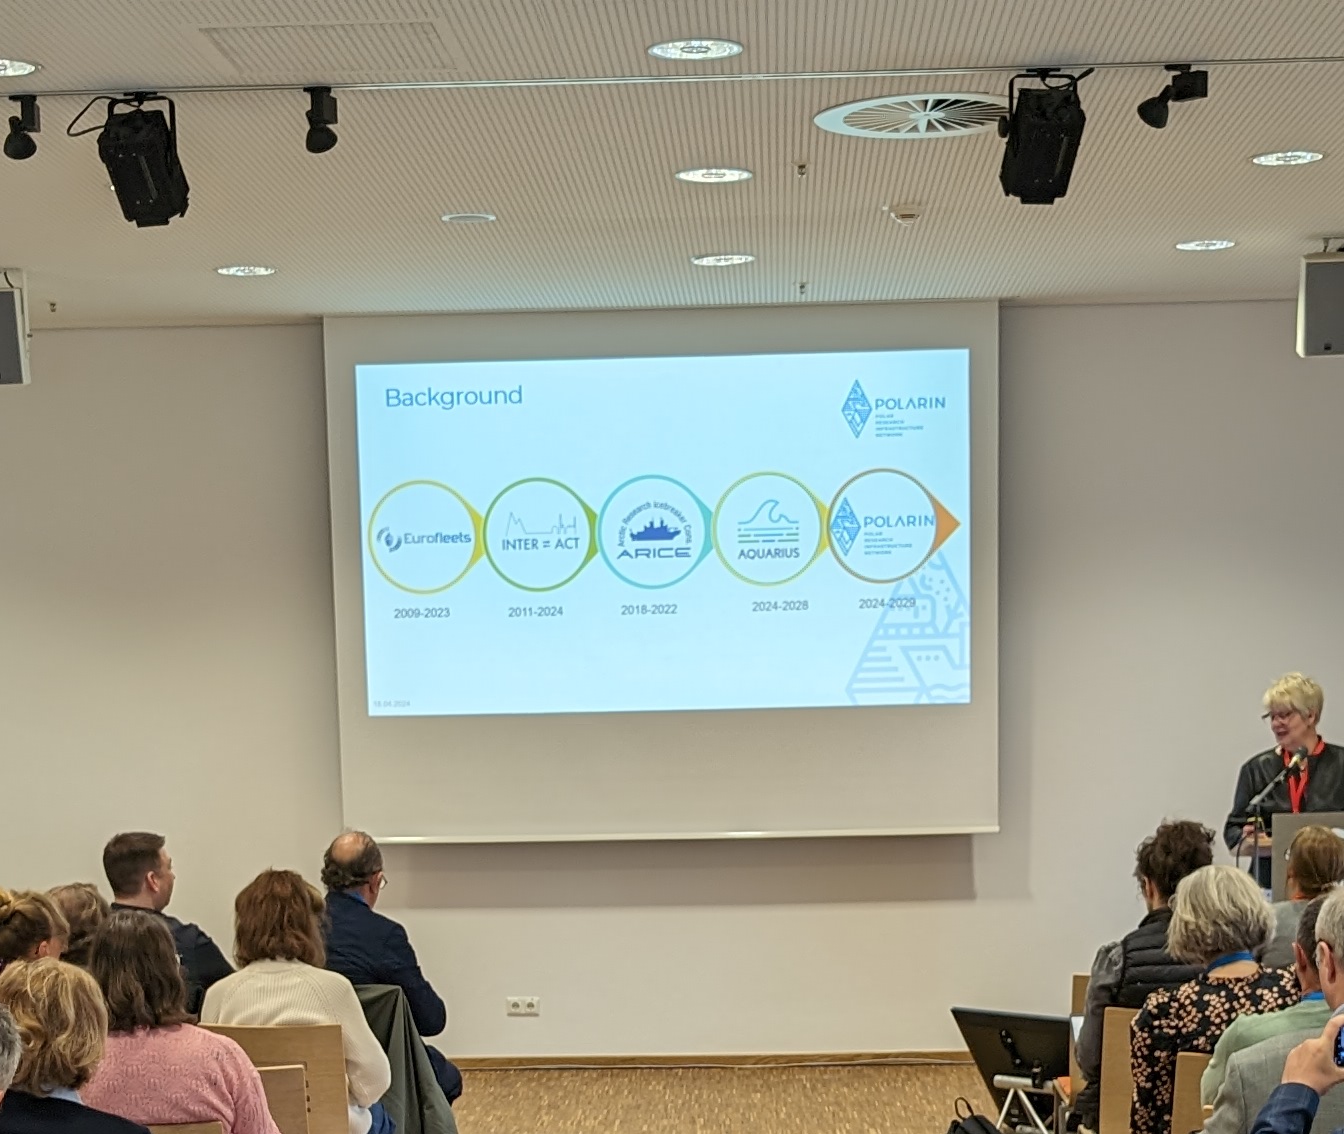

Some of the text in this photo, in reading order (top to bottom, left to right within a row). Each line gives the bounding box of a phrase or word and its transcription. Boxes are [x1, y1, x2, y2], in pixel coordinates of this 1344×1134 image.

[385, 384, 523, 410] Background
[874, 396, 946, 410] POLARIN
[863, 515, 935, 528] POLARIN
[403, 532, 472, 545] Eurofleets
[502, 538, 539, 551] INTER
[554, 537, 581, 550] ACT
[616, 547, 692, 560] ARICE
[737, 548, 800, 560] AQUARIUS
[508, 606, 564, 618] 2011-2024
[621, 604, 678, 616] 2018-2022
[752, 600, 809, 612] 2024-2028
[394, 607, 451, 619] 2009-2023
